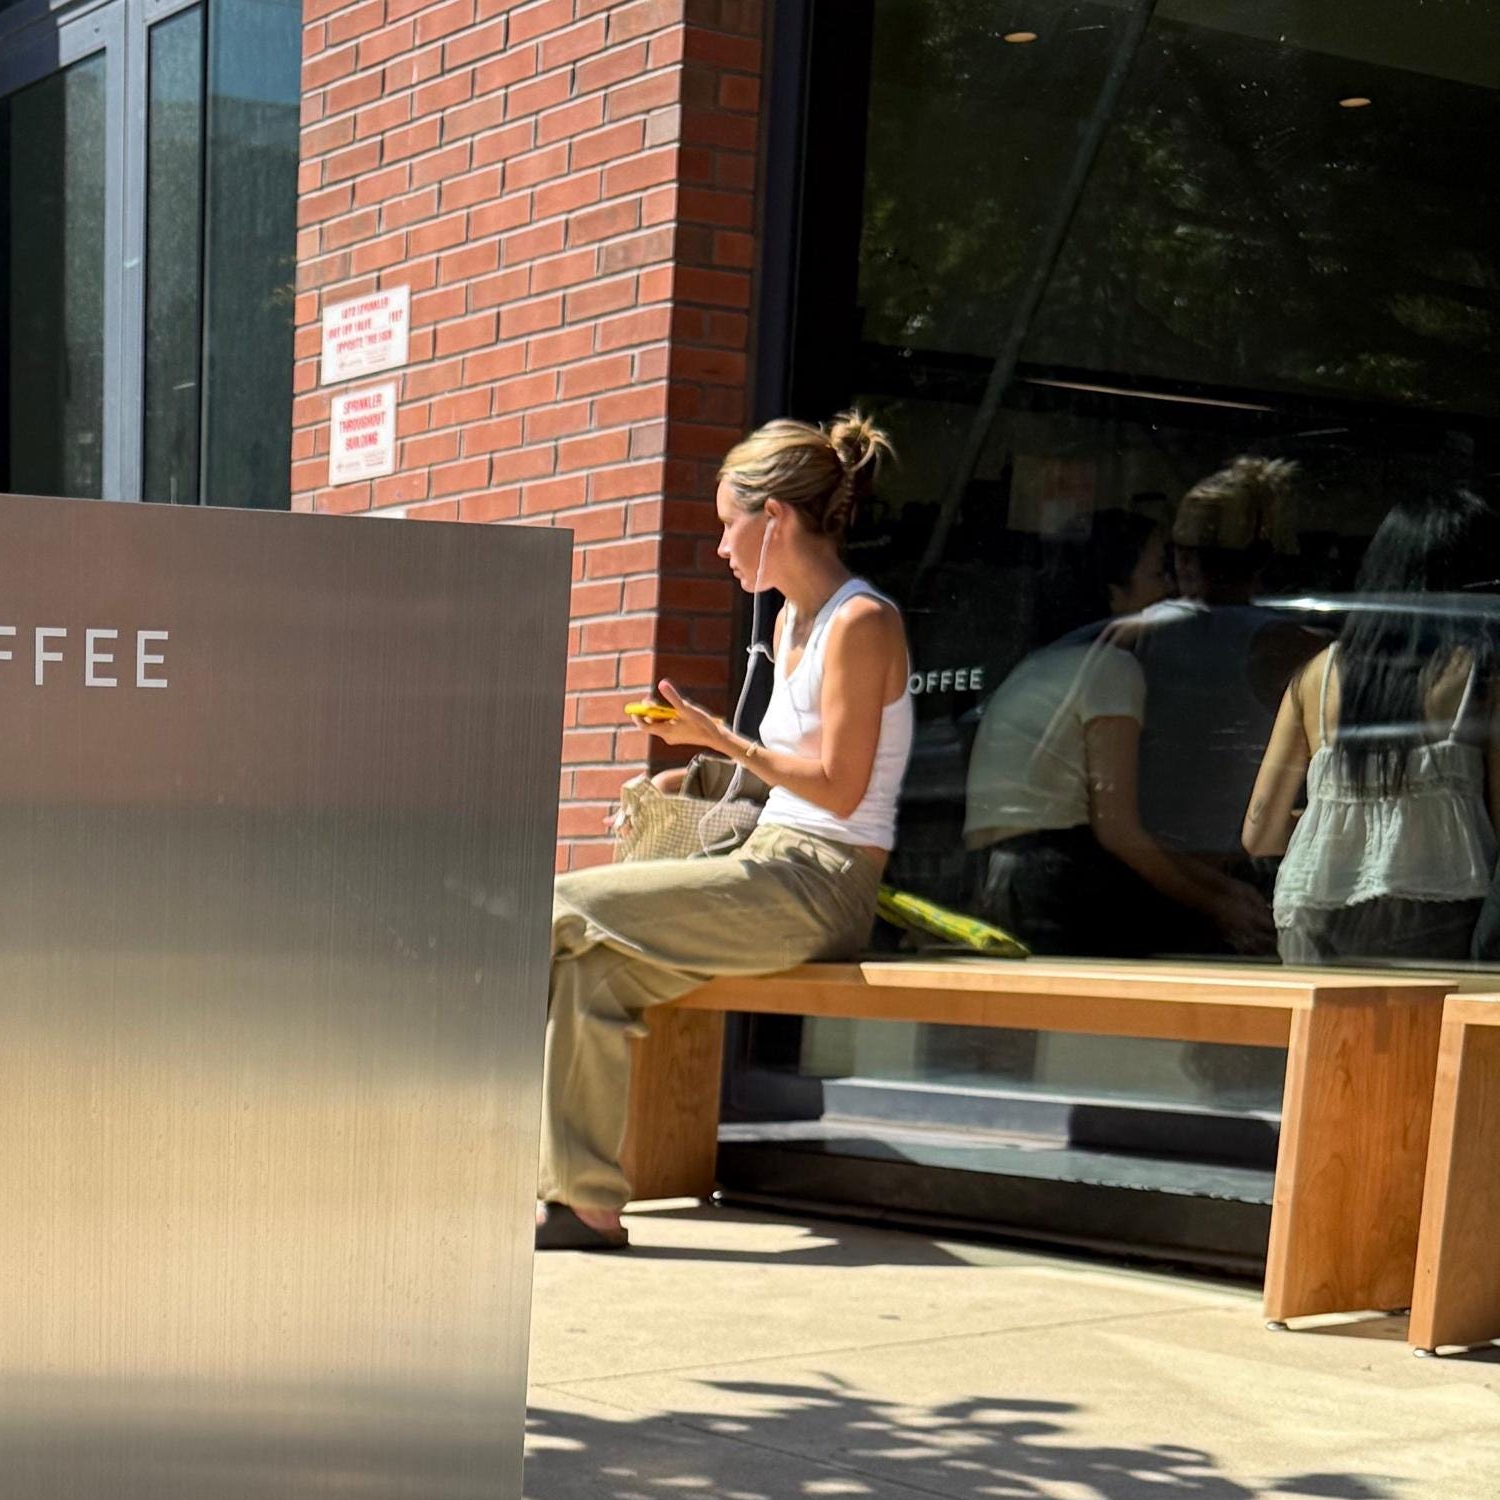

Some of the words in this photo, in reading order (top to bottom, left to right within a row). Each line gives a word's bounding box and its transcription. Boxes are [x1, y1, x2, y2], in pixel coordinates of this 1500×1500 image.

[343, 393, 382, 415] SPRINKLER
[340, 411, 385, 433] THROUGHOUT
[908, 668, 984, 695] OFFEE
